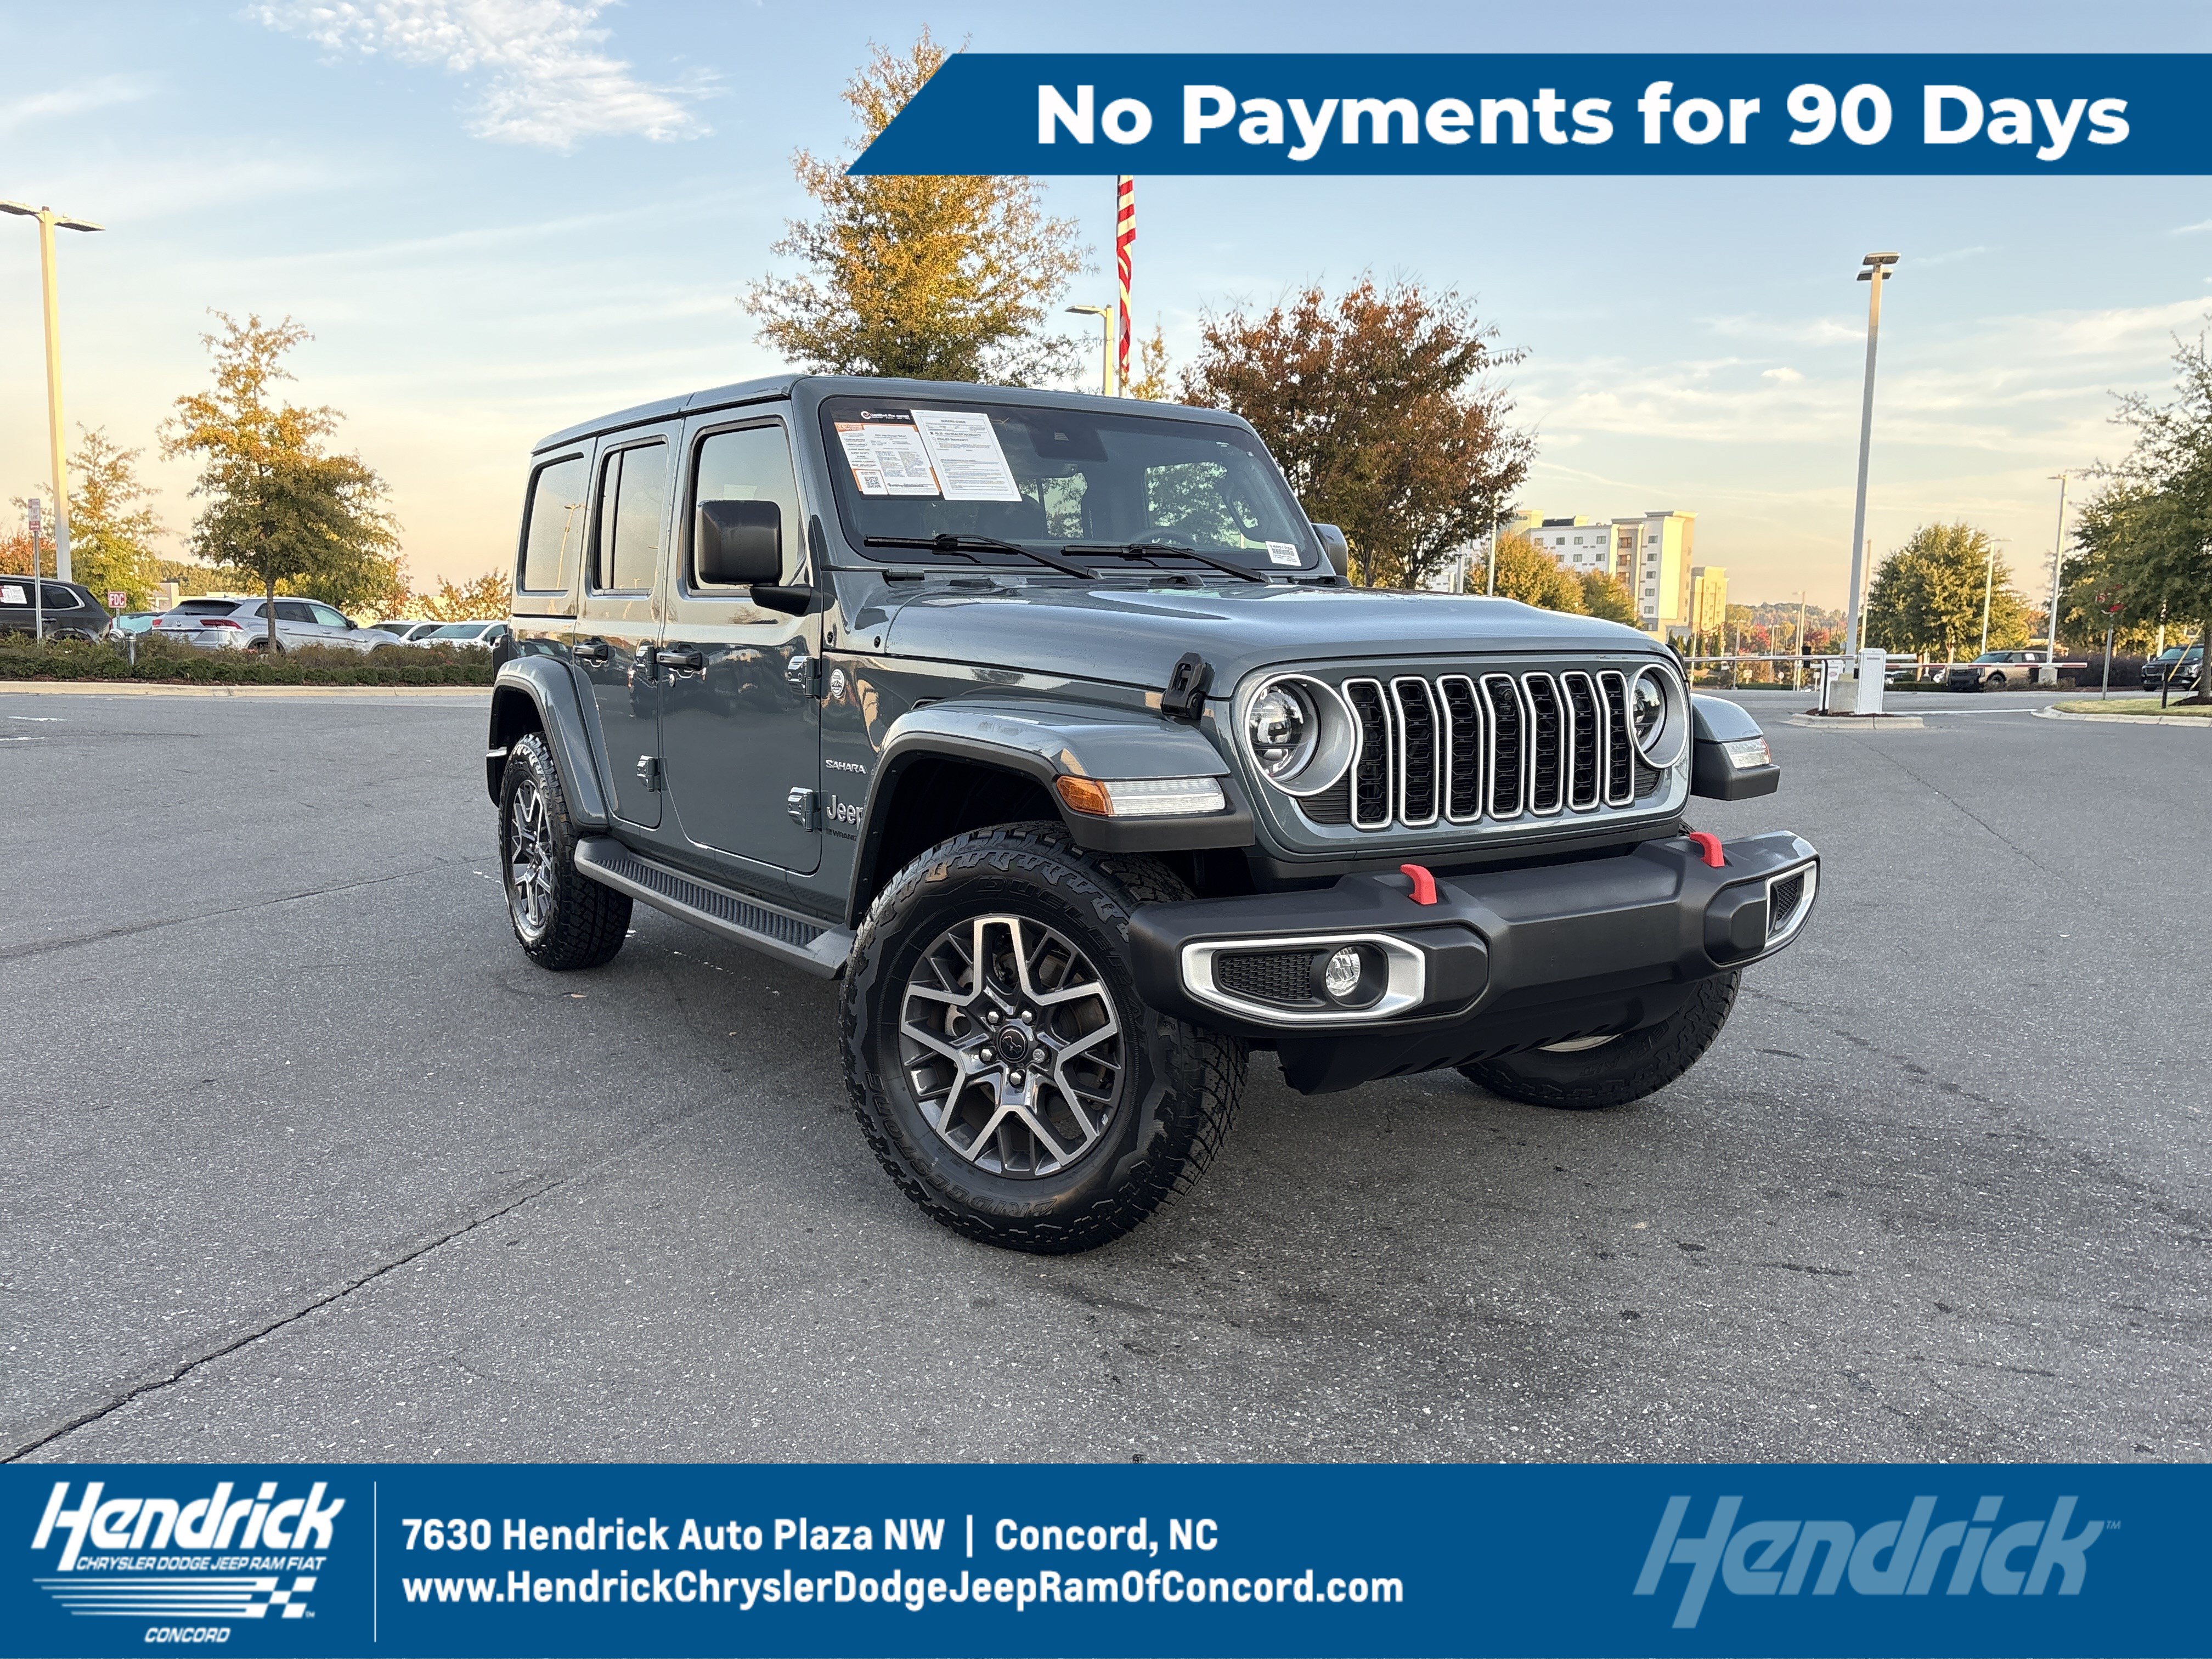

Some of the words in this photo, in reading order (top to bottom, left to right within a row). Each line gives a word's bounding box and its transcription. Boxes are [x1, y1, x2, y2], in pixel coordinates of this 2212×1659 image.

[110, 594, 125, 606] FDC
[825, 759, 868, 774] SAHARA
[977, 874, 1135, 986] DUELER
[865, 1070, 1058, 1219] BRIDGESTONE
